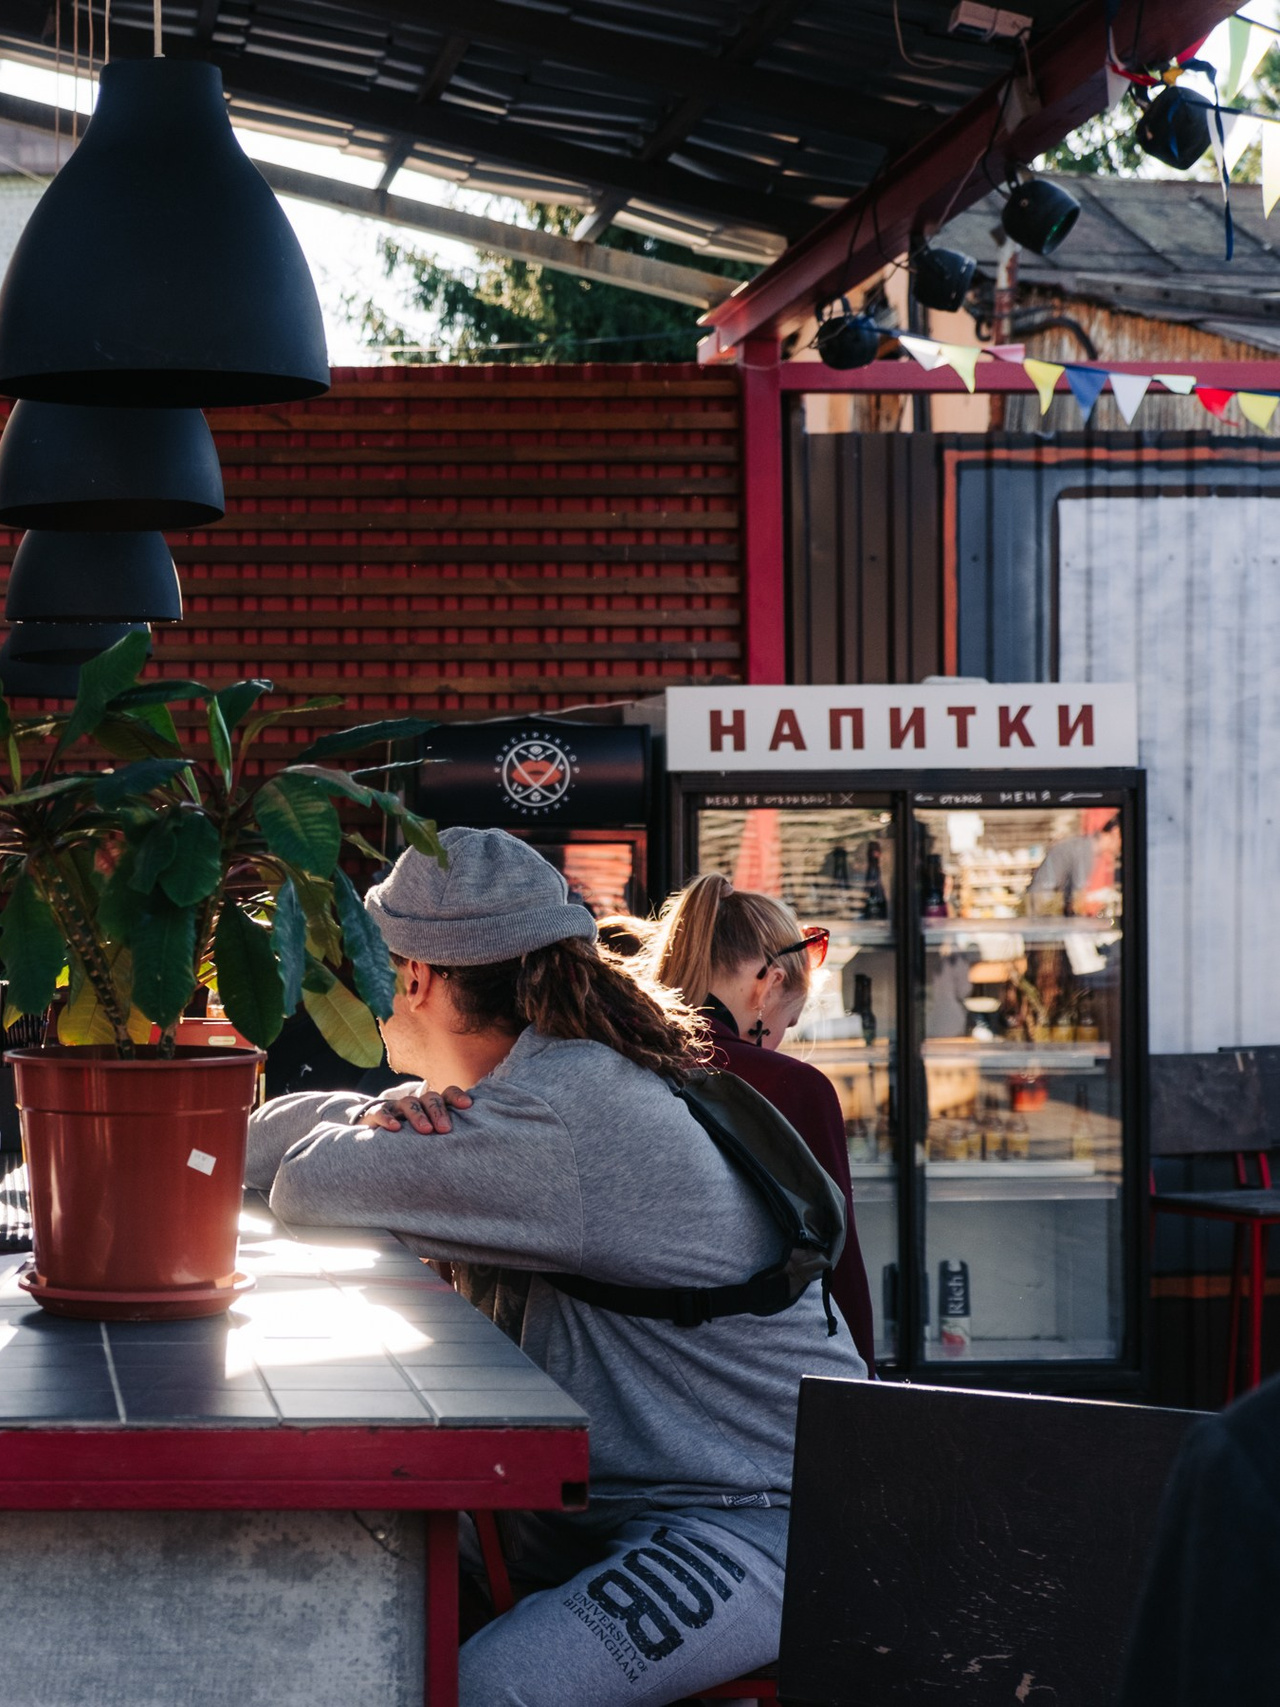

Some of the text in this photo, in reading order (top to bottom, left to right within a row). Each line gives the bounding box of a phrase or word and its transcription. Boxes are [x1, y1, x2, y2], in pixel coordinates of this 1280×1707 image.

[708, 704, 1095, 752] НАПИТКИ
[494, 731, 580, 774] КОНСТРУКТОР
[503, 795, 570, 815] ПРАКТИК
[999, 790, 1051, 803] МЕНЯ
[948, 1275, 965, 1314] Rich
[563, 1599, 640, 1684] BIRMINGHAM
[572, 1592, 649, 1674] UNIVERSITY OF
